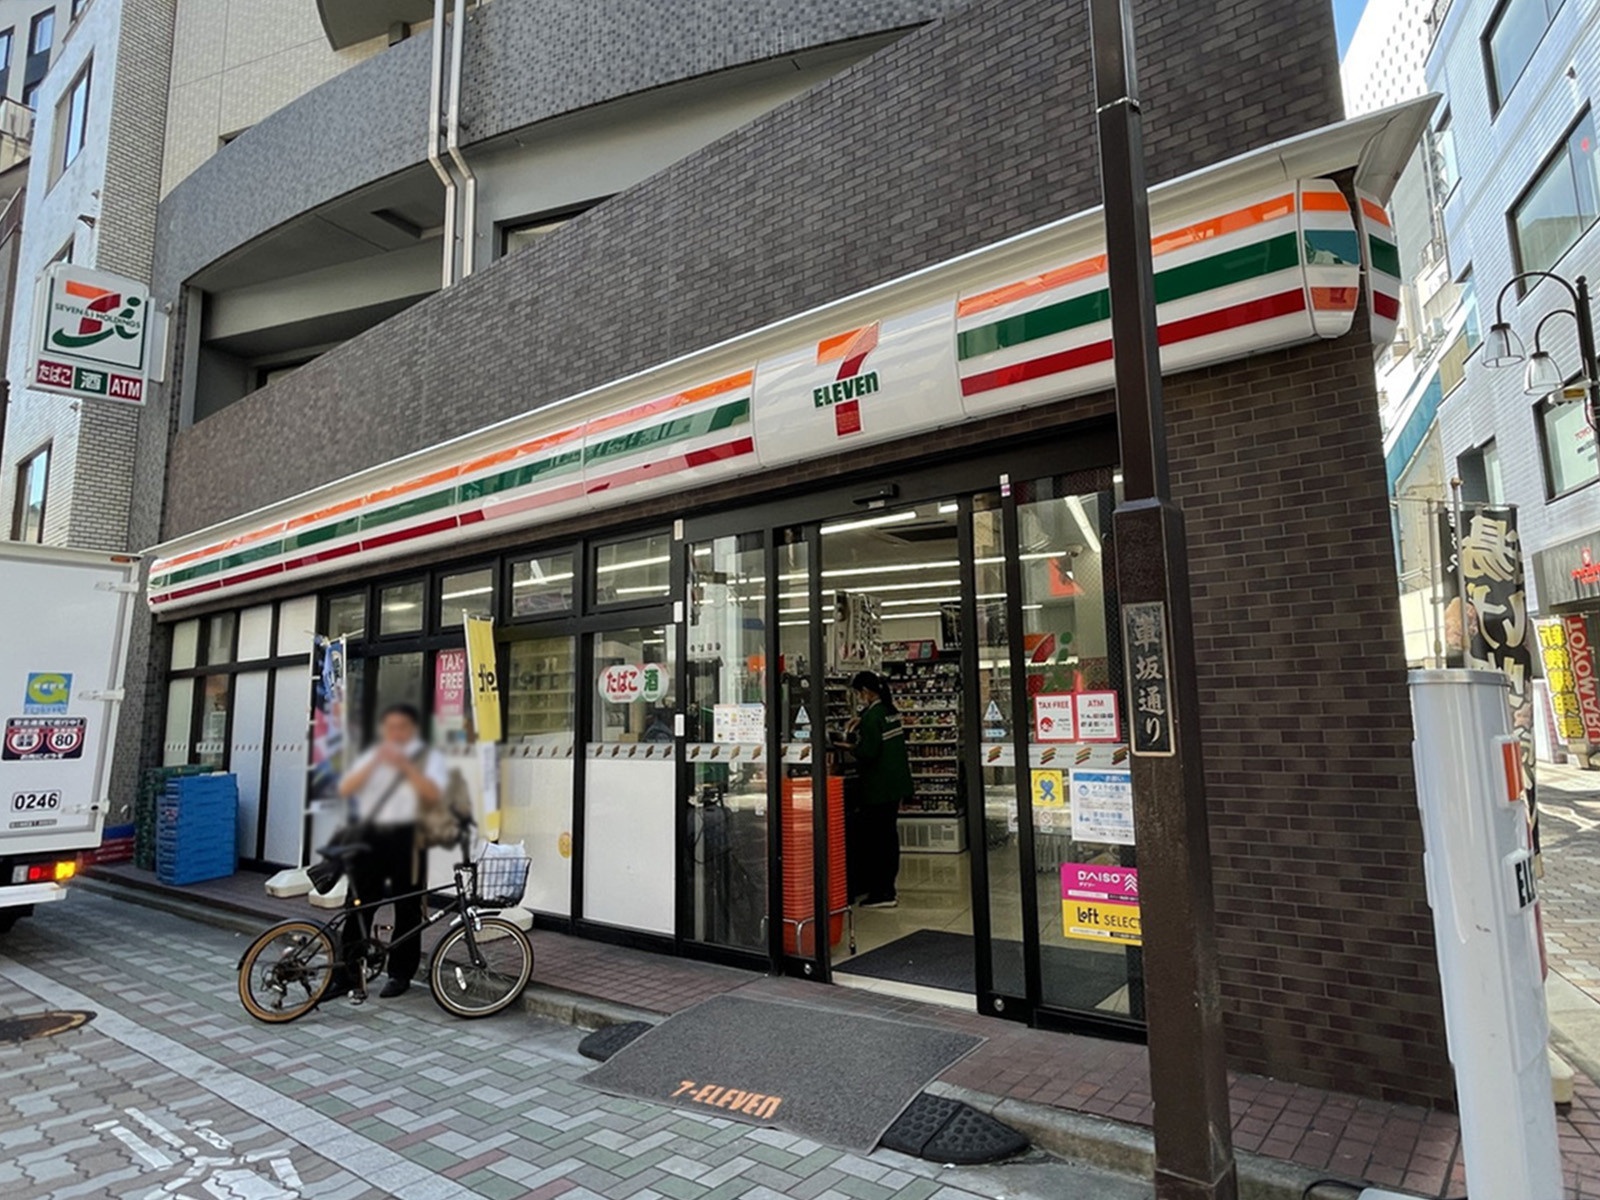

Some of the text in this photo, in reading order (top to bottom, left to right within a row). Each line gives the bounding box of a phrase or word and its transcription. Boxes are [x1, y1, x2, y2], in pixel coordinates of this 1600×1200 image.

[55, 303, 83, 315] SEVEN
[95, 313, 141, 329] HOLDINGS
[38, 364, 71, 385] たばこ
[80, 371, 102, 390] 酒
[111, 379, 140, 398] ATM
[440, 672, 463, 690] FREE
[606, 671, 638, 693] たばこ
[644, 669, 659, 692] 酒
[444, 690, 459, 700] SHOP
[55, 734, 74, 747] 80
[15, 792, 58, 810] 0246
[1077, 870, 1120, 884] DAISO
